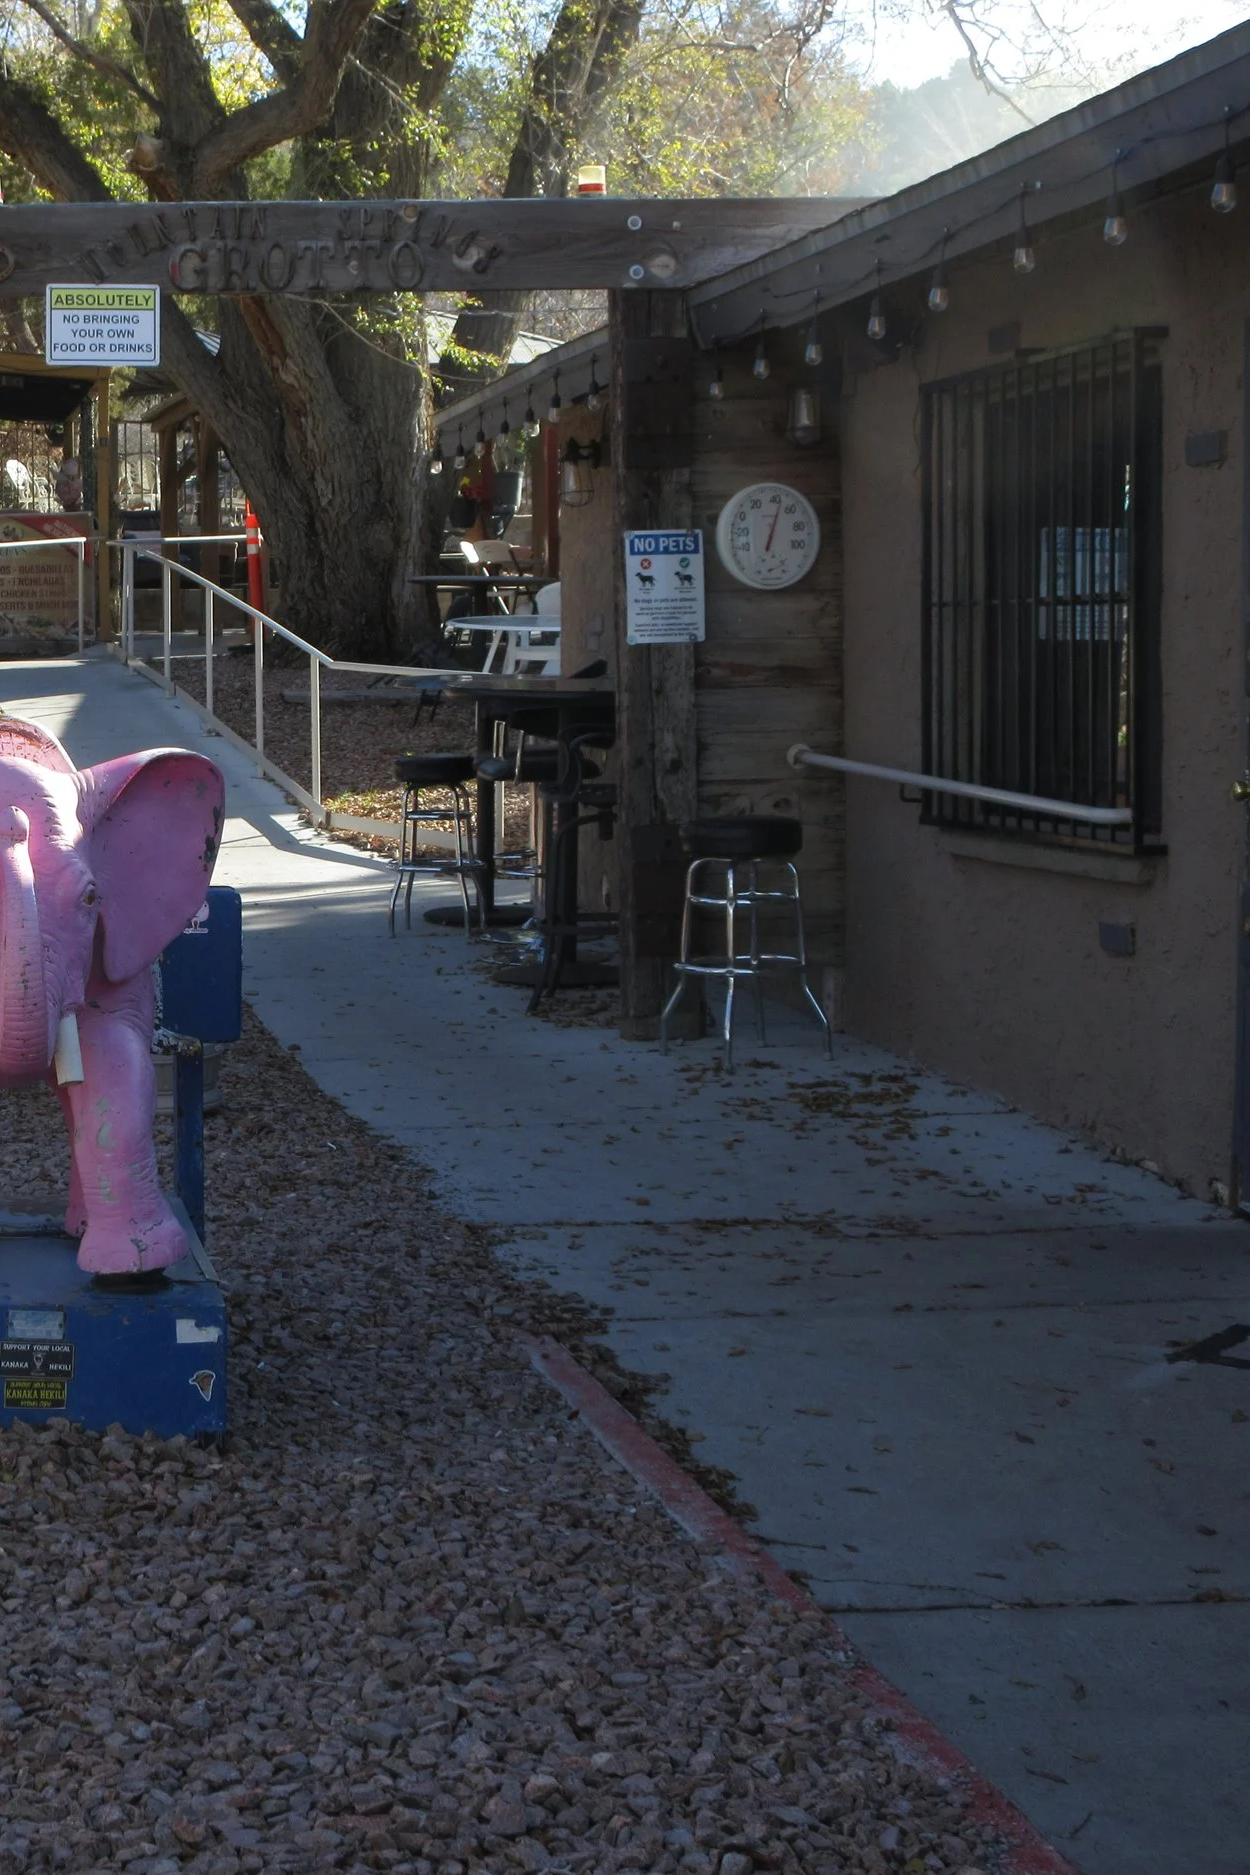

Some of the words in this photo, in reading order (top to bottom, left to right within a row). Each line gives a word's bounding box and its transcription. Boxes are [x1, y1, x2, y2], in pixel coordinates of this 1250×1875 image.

[168, 239, 426, 292] GROTTO
[54, 294, 152, 306] ABSOLUTELY
[63, 315, 80, 324] NO
[83, 314, 140, 325] BRINGING
[71, 328, 104, 339] YOUR
[107, 328, 135, 339] OWN
[53, 343, 86, 353] FOOD
[89, 343, 106, 353] OR
[109, 343, 153, 353] DRINKS
[750, 499, 762, 509] 20
[769, 494, 781, 504] 40
[784, 504, 797, 514] 60
[739, 511, 746, 521] 0
[793, 521, 805, 531] 80
[634, 538, 655, 552] NO
[659, 537, 695, 551] PETS
[790, 540, 806, 549] 100
[0, 588, 37, 598] CHICKEN
[32, 1344, 50, 1352] YOUR
[1, 1361, 29, 1369] KANAKA
[49, 1363, 71, 1371] HEKILI
[6, 1389, 38, 1399] KANAKA
[40, 1389, 65, 1399] HEKILI
